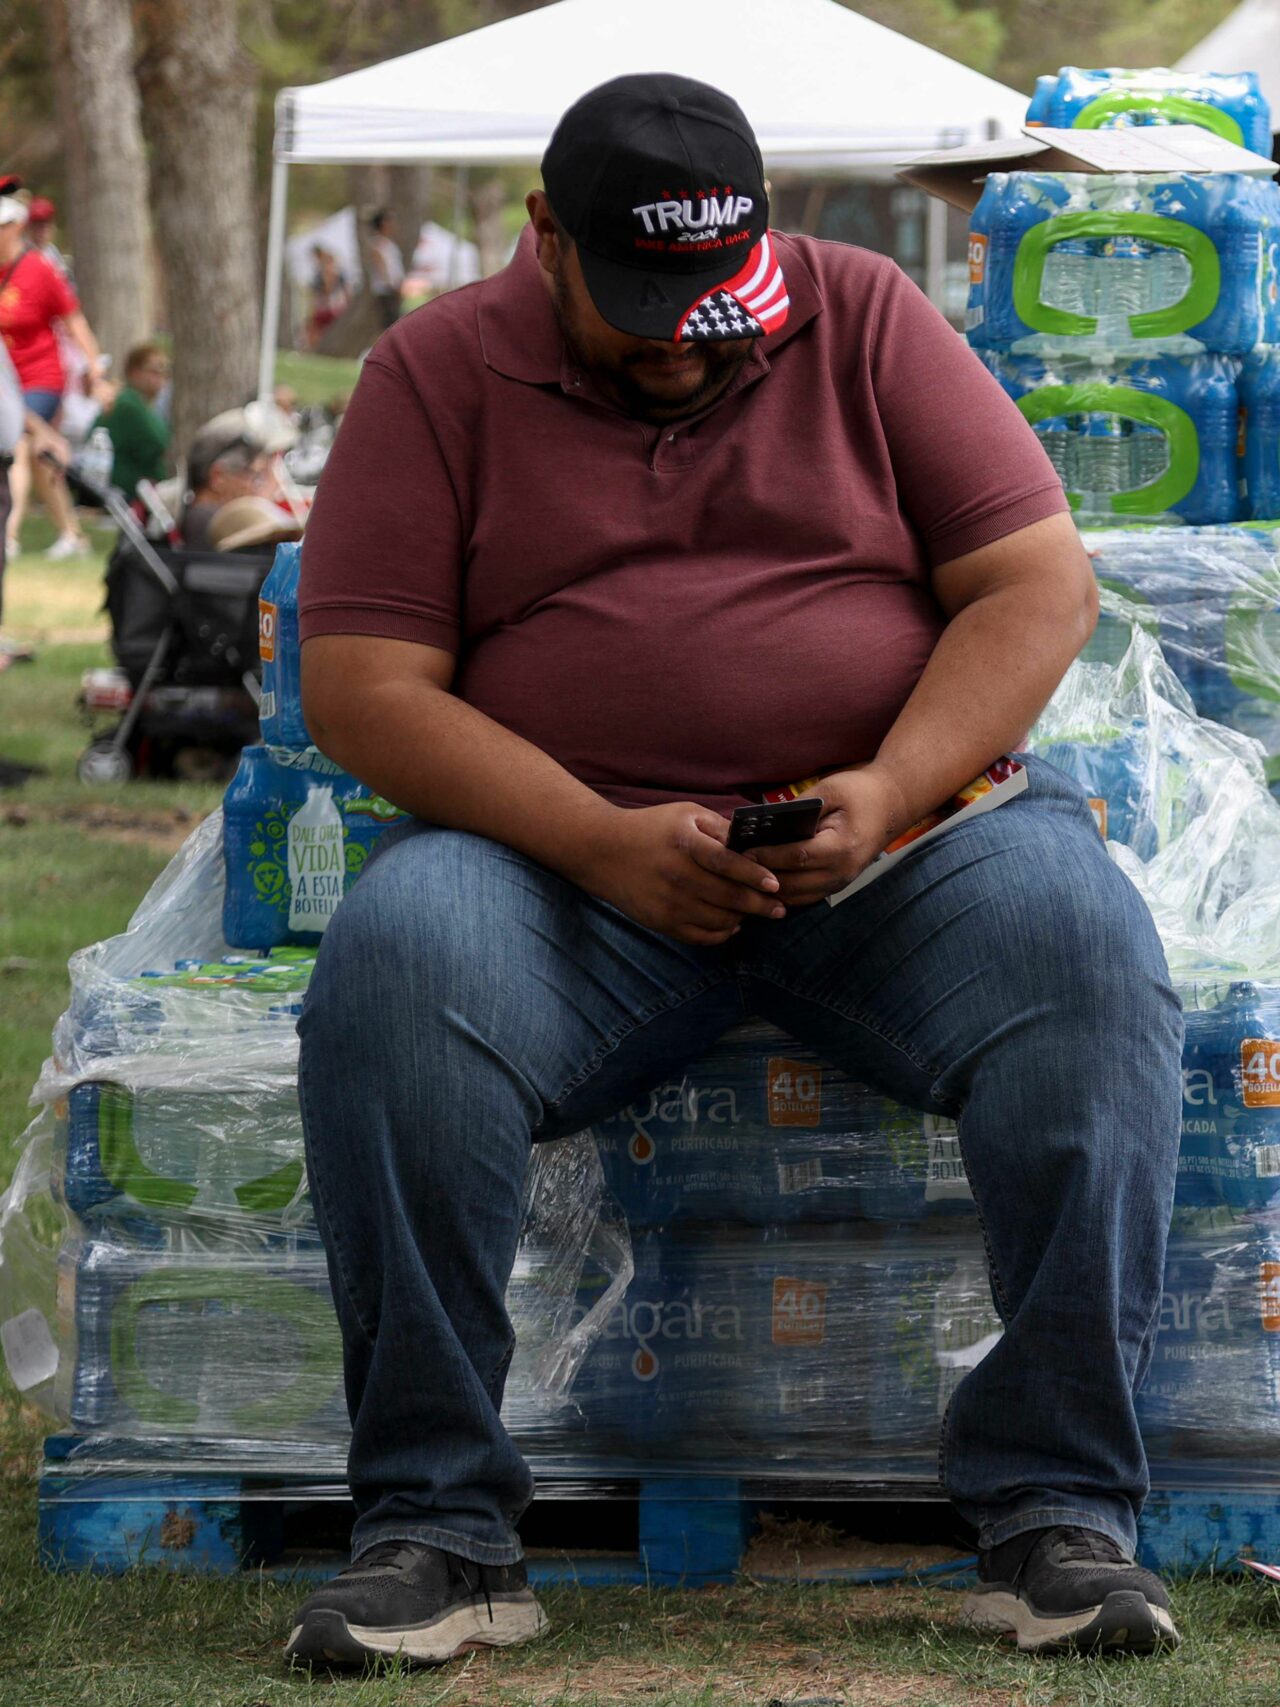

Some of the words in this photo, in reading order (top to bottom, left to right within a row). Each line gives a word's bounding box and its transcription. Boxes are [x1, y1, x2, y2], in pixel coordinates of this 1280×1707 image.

[632, 195, 753, 234] TRUMP
[668, 239, 723, 253] AMERICA
[725, 229, 751, 245] BACK
[677, 227, 719, 242] 2024
[968, 242, 983, 264] 0
[259, 612, 274, 638] 0
[292, 825, 316, 843] DALE
[292, 843, 340, 873] VIDA
[296, 876, 307, 897] A
[313, 875, 340, 897] ESTA
[771, 1071, 818, 1101] 40
[773, 1102, 817, 1113] BOTELLAS
[1182, 1120, 1217, 1134] ICADA
[599, 1138, 618, 1151] GUA
[671, 1137, 739, 1151] PURIFICADA
[777, 1287, 821, 1321] 40
[674, 1354, 742, 1369] PURIFICADA
